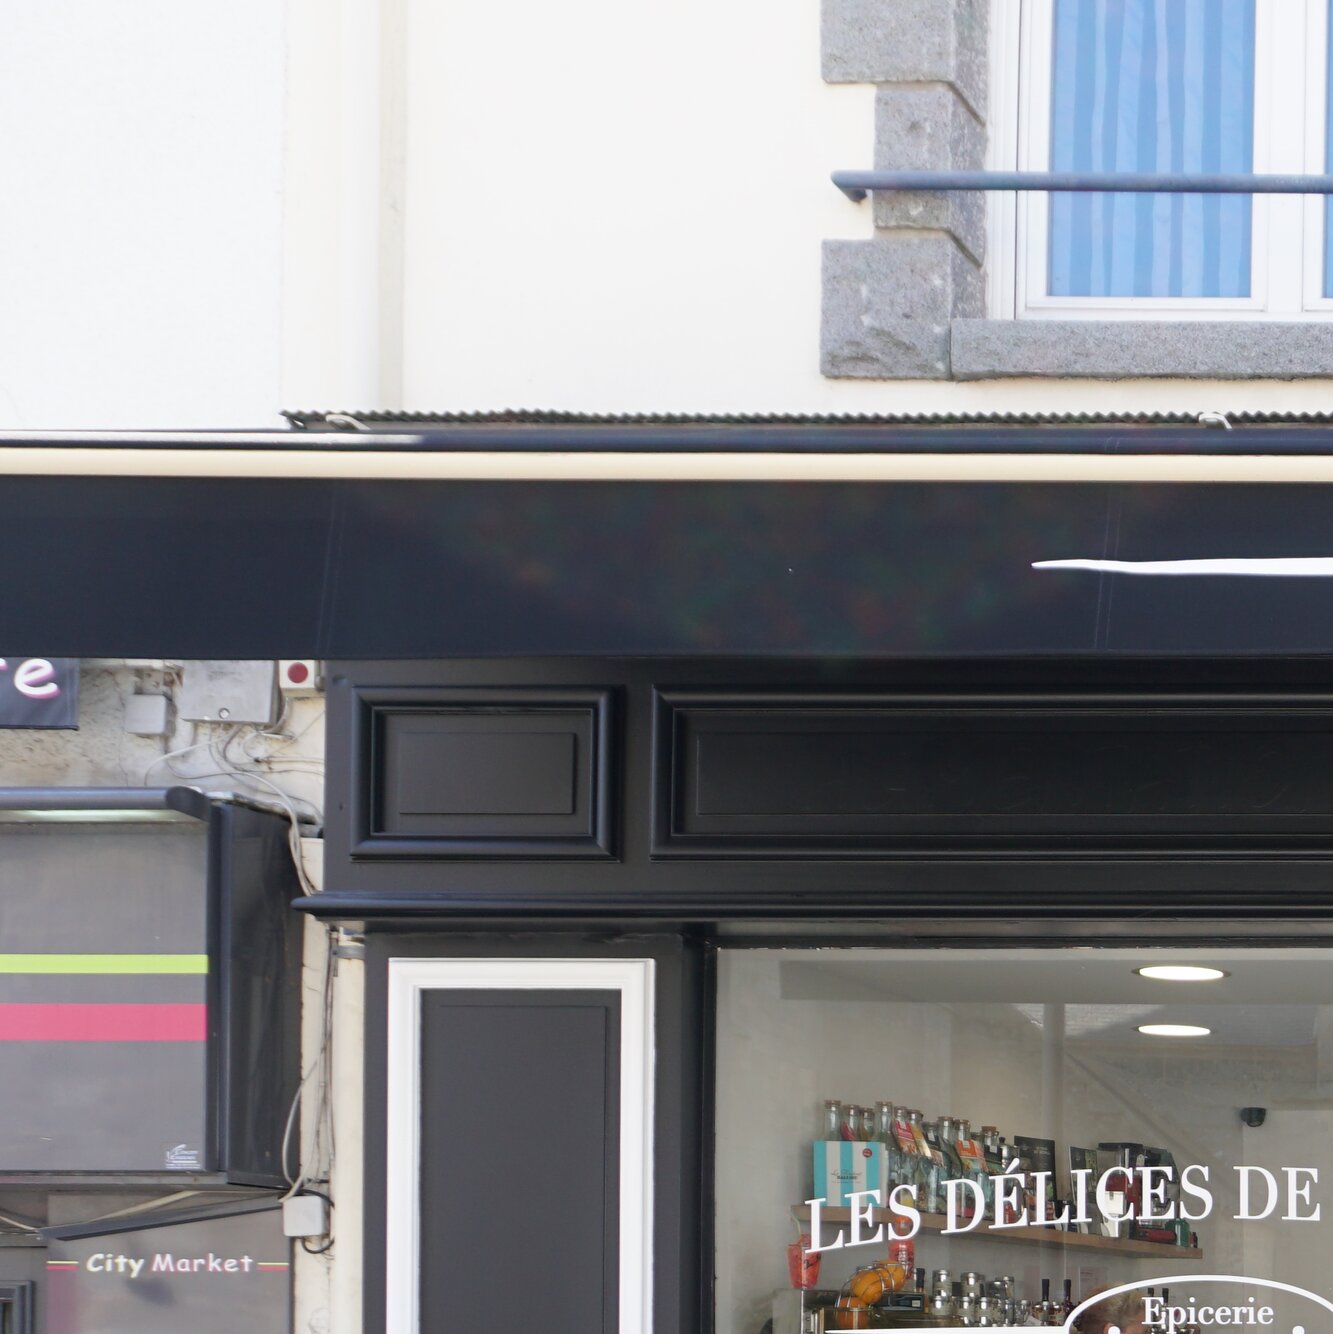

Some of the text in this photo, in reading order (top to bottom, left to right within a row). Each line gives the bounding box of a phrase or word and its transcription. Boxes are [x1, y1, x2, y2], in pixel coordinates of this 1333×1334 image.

[804, 1184, 921, 1254] LES
[941, 1157, 1213, 1236] DÉLICES
[1233, 1165, 1321, 1221] DE
[86, 1252, 254, 1278] City Market
